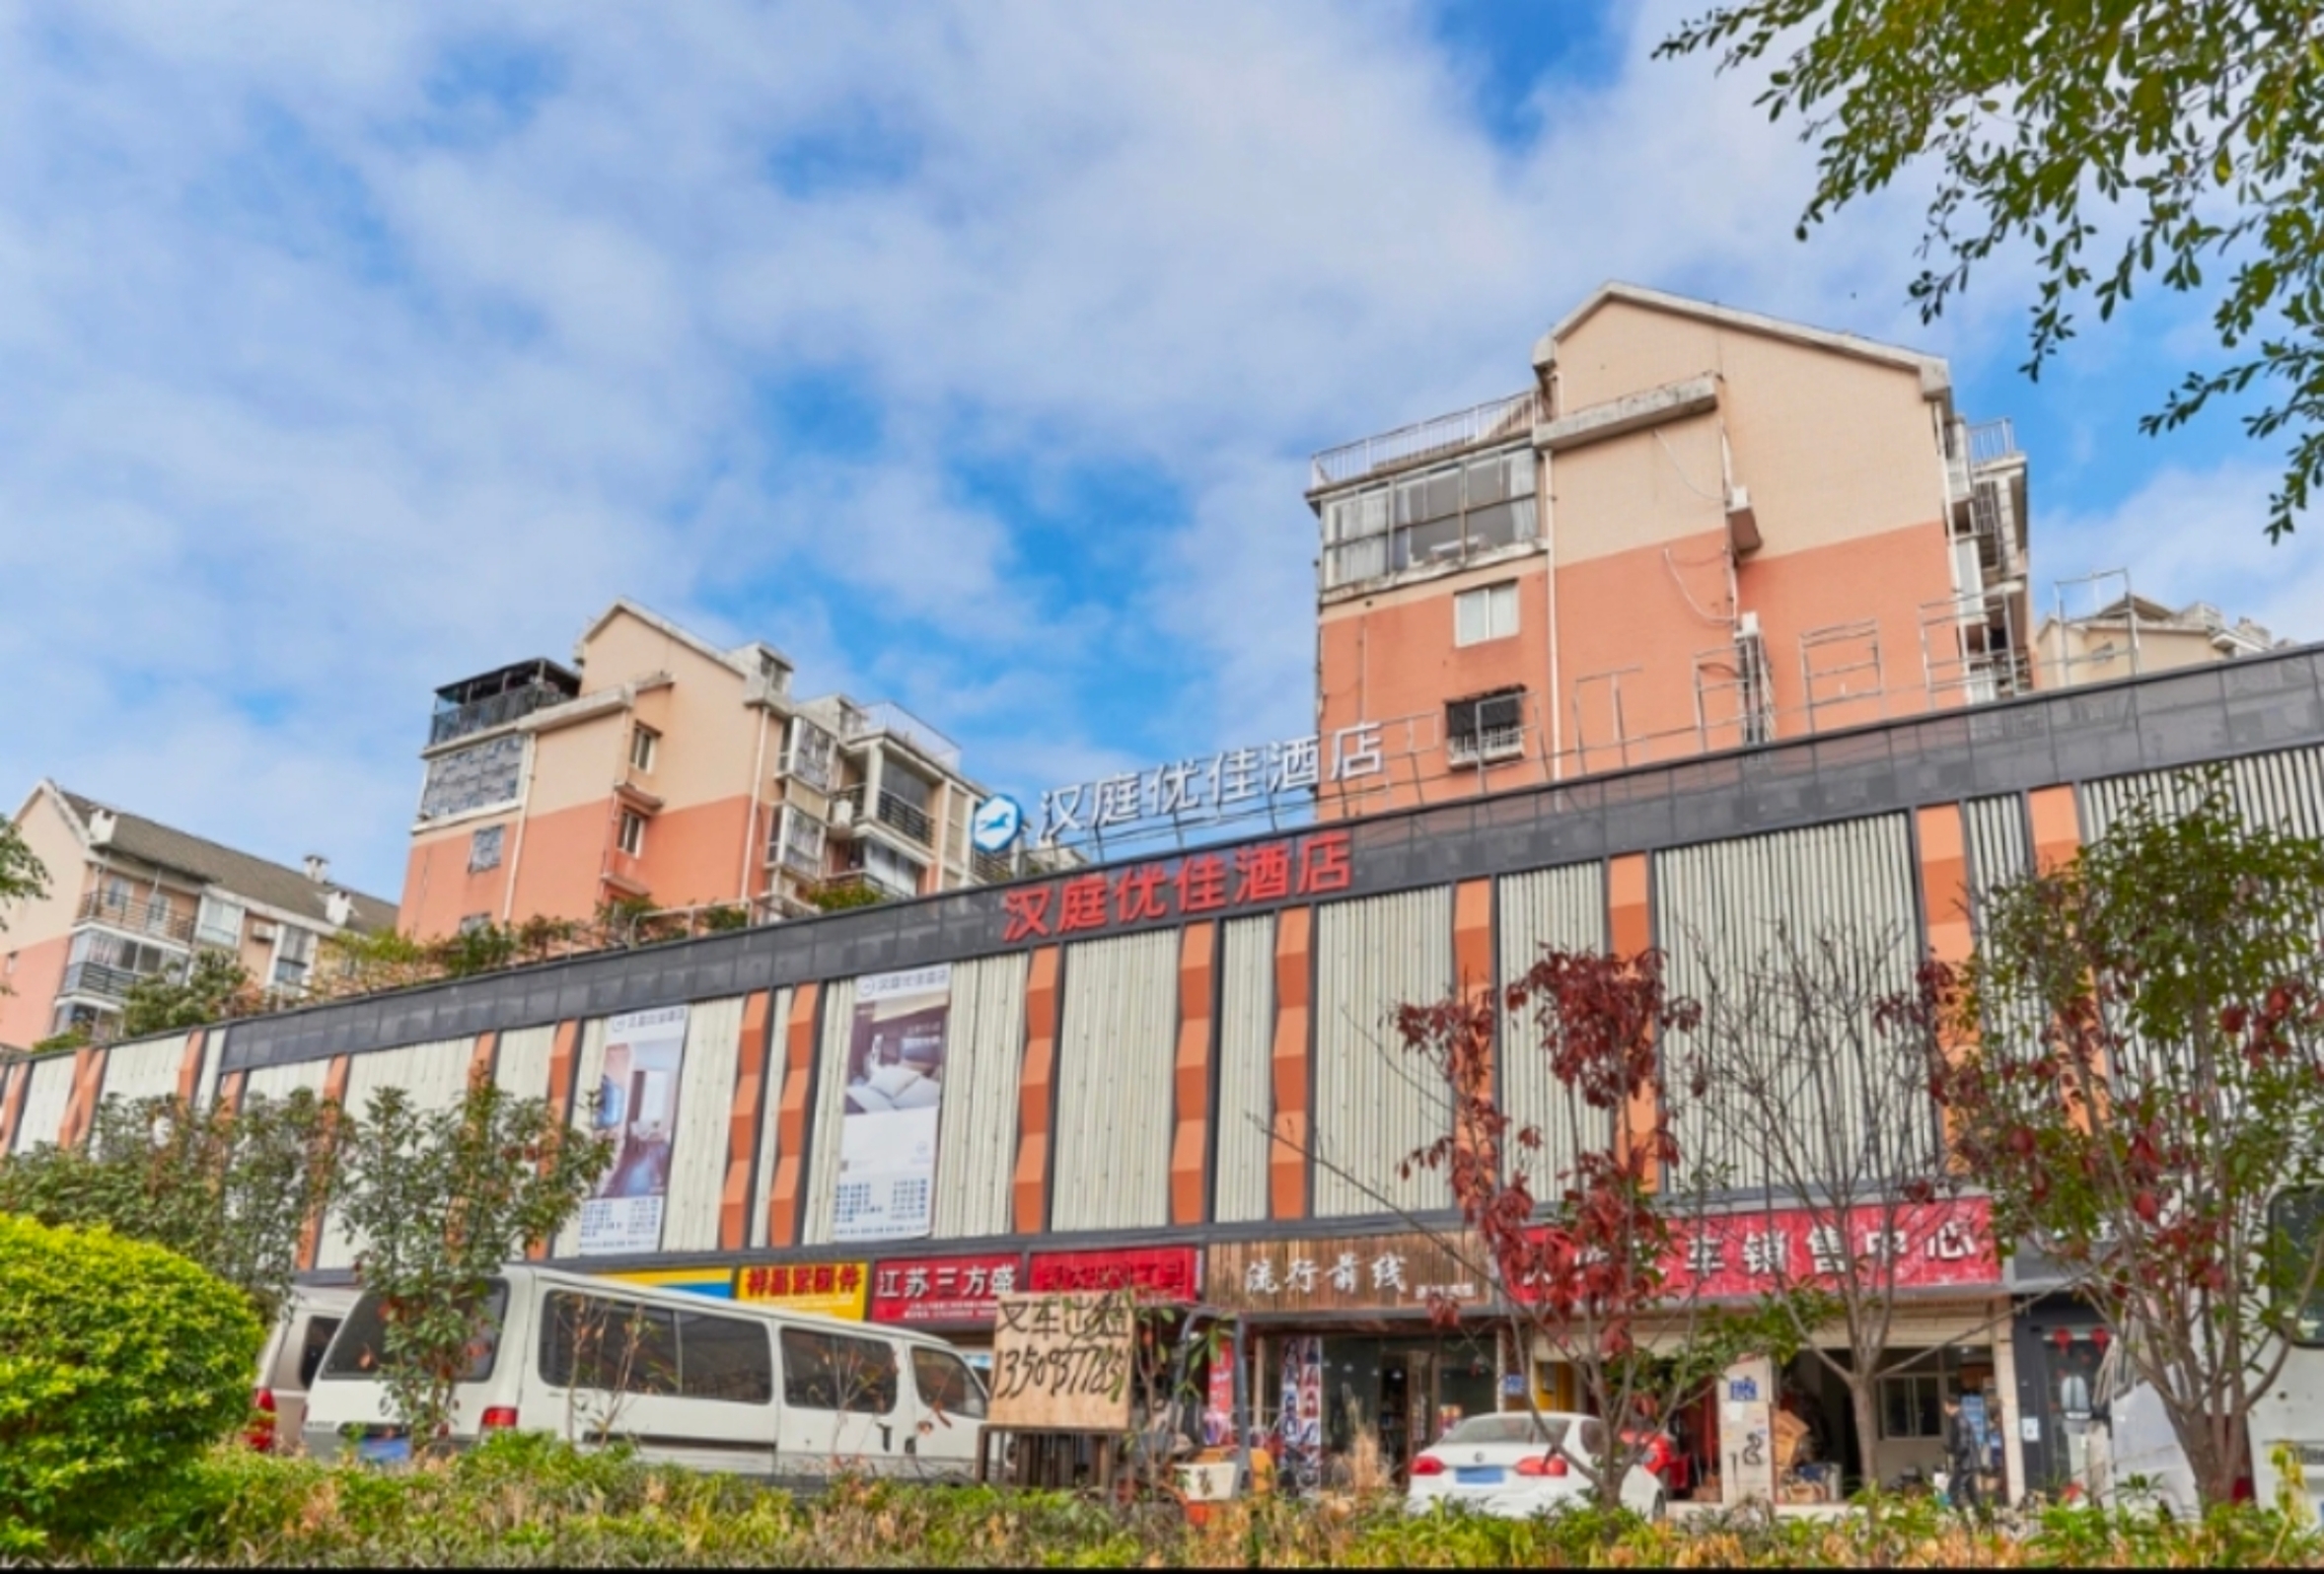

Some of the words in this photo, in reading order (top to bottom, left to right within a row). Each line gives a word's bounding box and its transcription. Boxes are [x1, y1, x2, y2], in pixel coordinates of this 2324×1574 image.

[1038, 721, 1383, 841] 汉庭优佳酒店
[1001, 831, 1352, 943] 汉庭优佳酒店
[1522, 1220, 1976, 1285] 车销售中心
